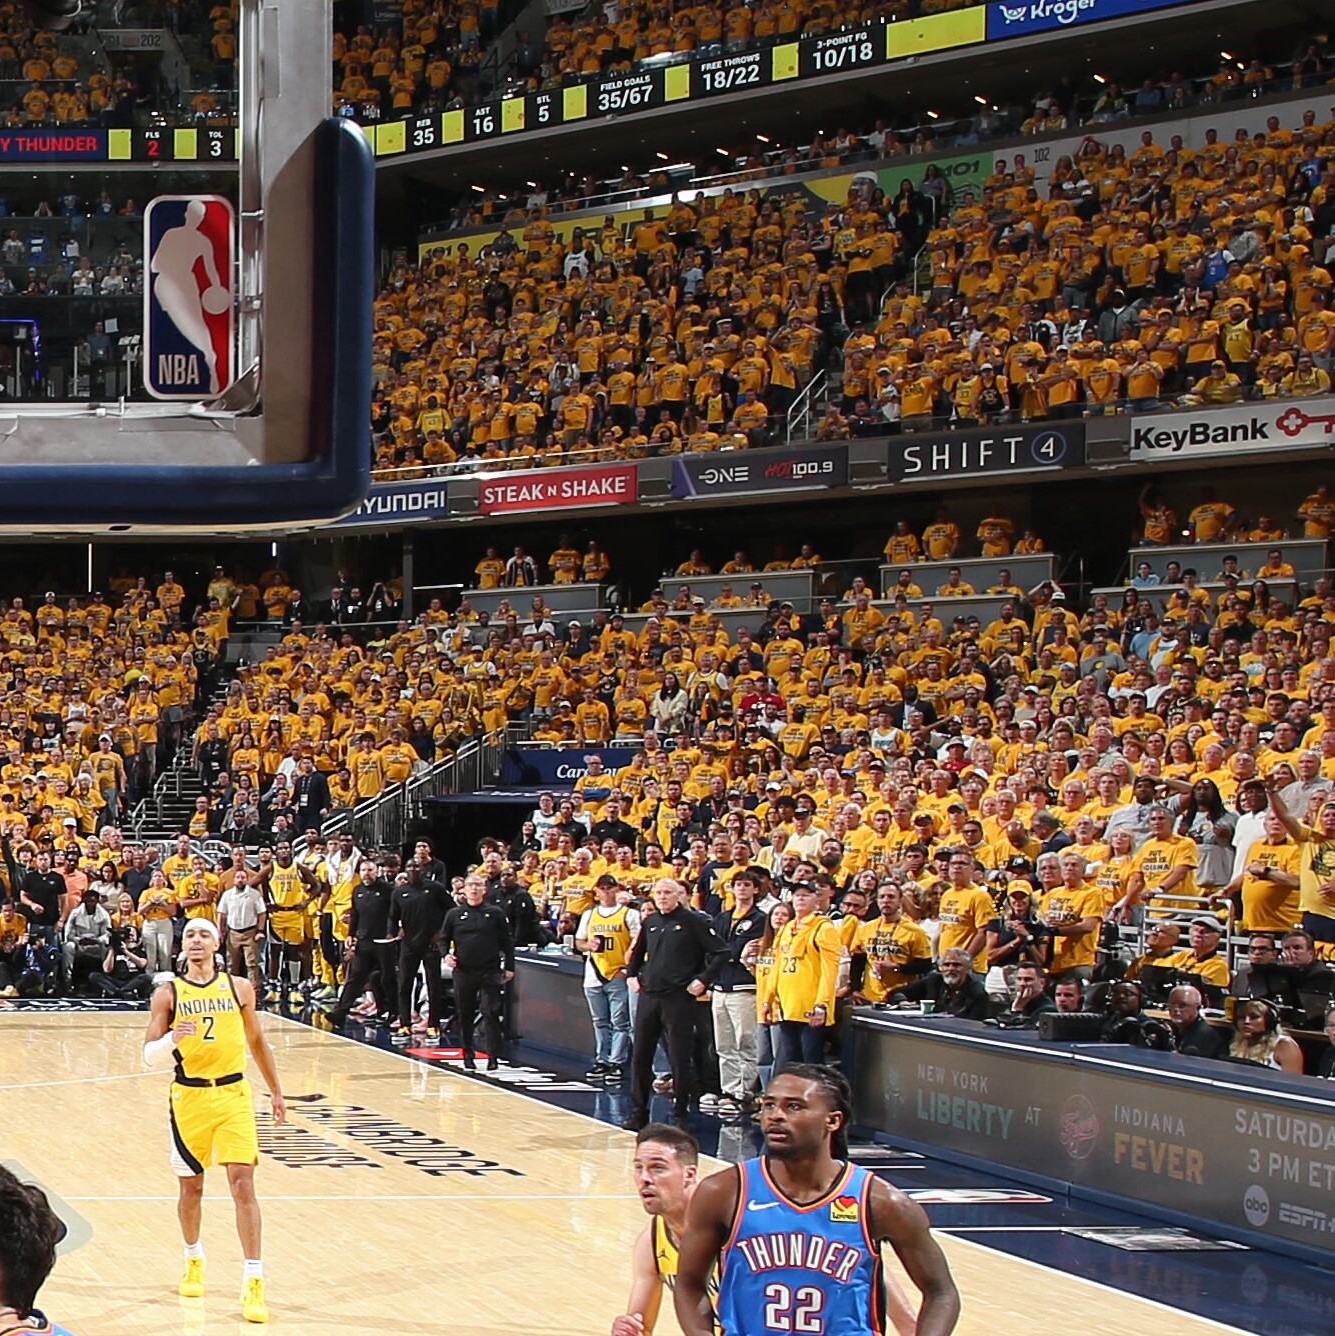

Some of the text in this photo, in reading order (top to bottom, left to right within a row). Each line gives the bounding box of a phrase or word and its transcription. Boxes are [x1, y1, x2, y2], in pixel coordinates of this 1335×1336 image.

[1030, 0, 1096, 24] Kroger
[140, 34, 161, 48] 202
[816, 31, 868, 49] 3-POINT FG
[701, 53, 761, 71] FREE THROWS
[812, 41, 874, 70] 10/18
[600, 75, 651, 91] FIELD GOALS
[702, 64, 760, 92] 18/22
[537, 95, 551, 104] STL
[598, 85, 654, 111] 35/67
[476, 107, 490, 117] AST
[538, 106, 549, 122] 5
[416, 119, 431, 128] REB
[473, 117, 494, 135] 16
[15, 136, 98, 152] THUNDER
[208, 131, 223, 139] TOL
[413, 129, 434, 147] 35
[147, 139, 159, 156] 2
[209, 139, 222, 157] 3
[1033, 147, 1050, 163] 102
[158, 354, 200, 385] NBA
[1133, 417, 1271, 452] KeyBank
[903, 437, 1055, 473] SHIFT 4
[484, 476, 627, 504] STEAK N SHAKE
[353, 490, 445, 516] YUNDAI
[781, 957, 797, 974] 23
[177, 998, 234, 1017] INDIANA
[202, 1016, 215, 1041] 2
[918, 1063, 989, 1094] NEW YORK
[917, 1090, 1015, 1139] LIBERTY
[1025, 1106, 1041, 1127] AT
[1114, 1104, 1186, 1138] INDIANA
[286, 1103, 527, 1177] GAINBRIDGE
[1113, 1132, 1205, 1185] FEVER
[1247, 1148, 1262, 1174] 3
[1268, 1151, 1300, 1183] PM
[1245, 1196, 1268, 1213] abc
[736, 1233, 862, 1283] THUNDER
[765, 1283, 824, 1334] 22
